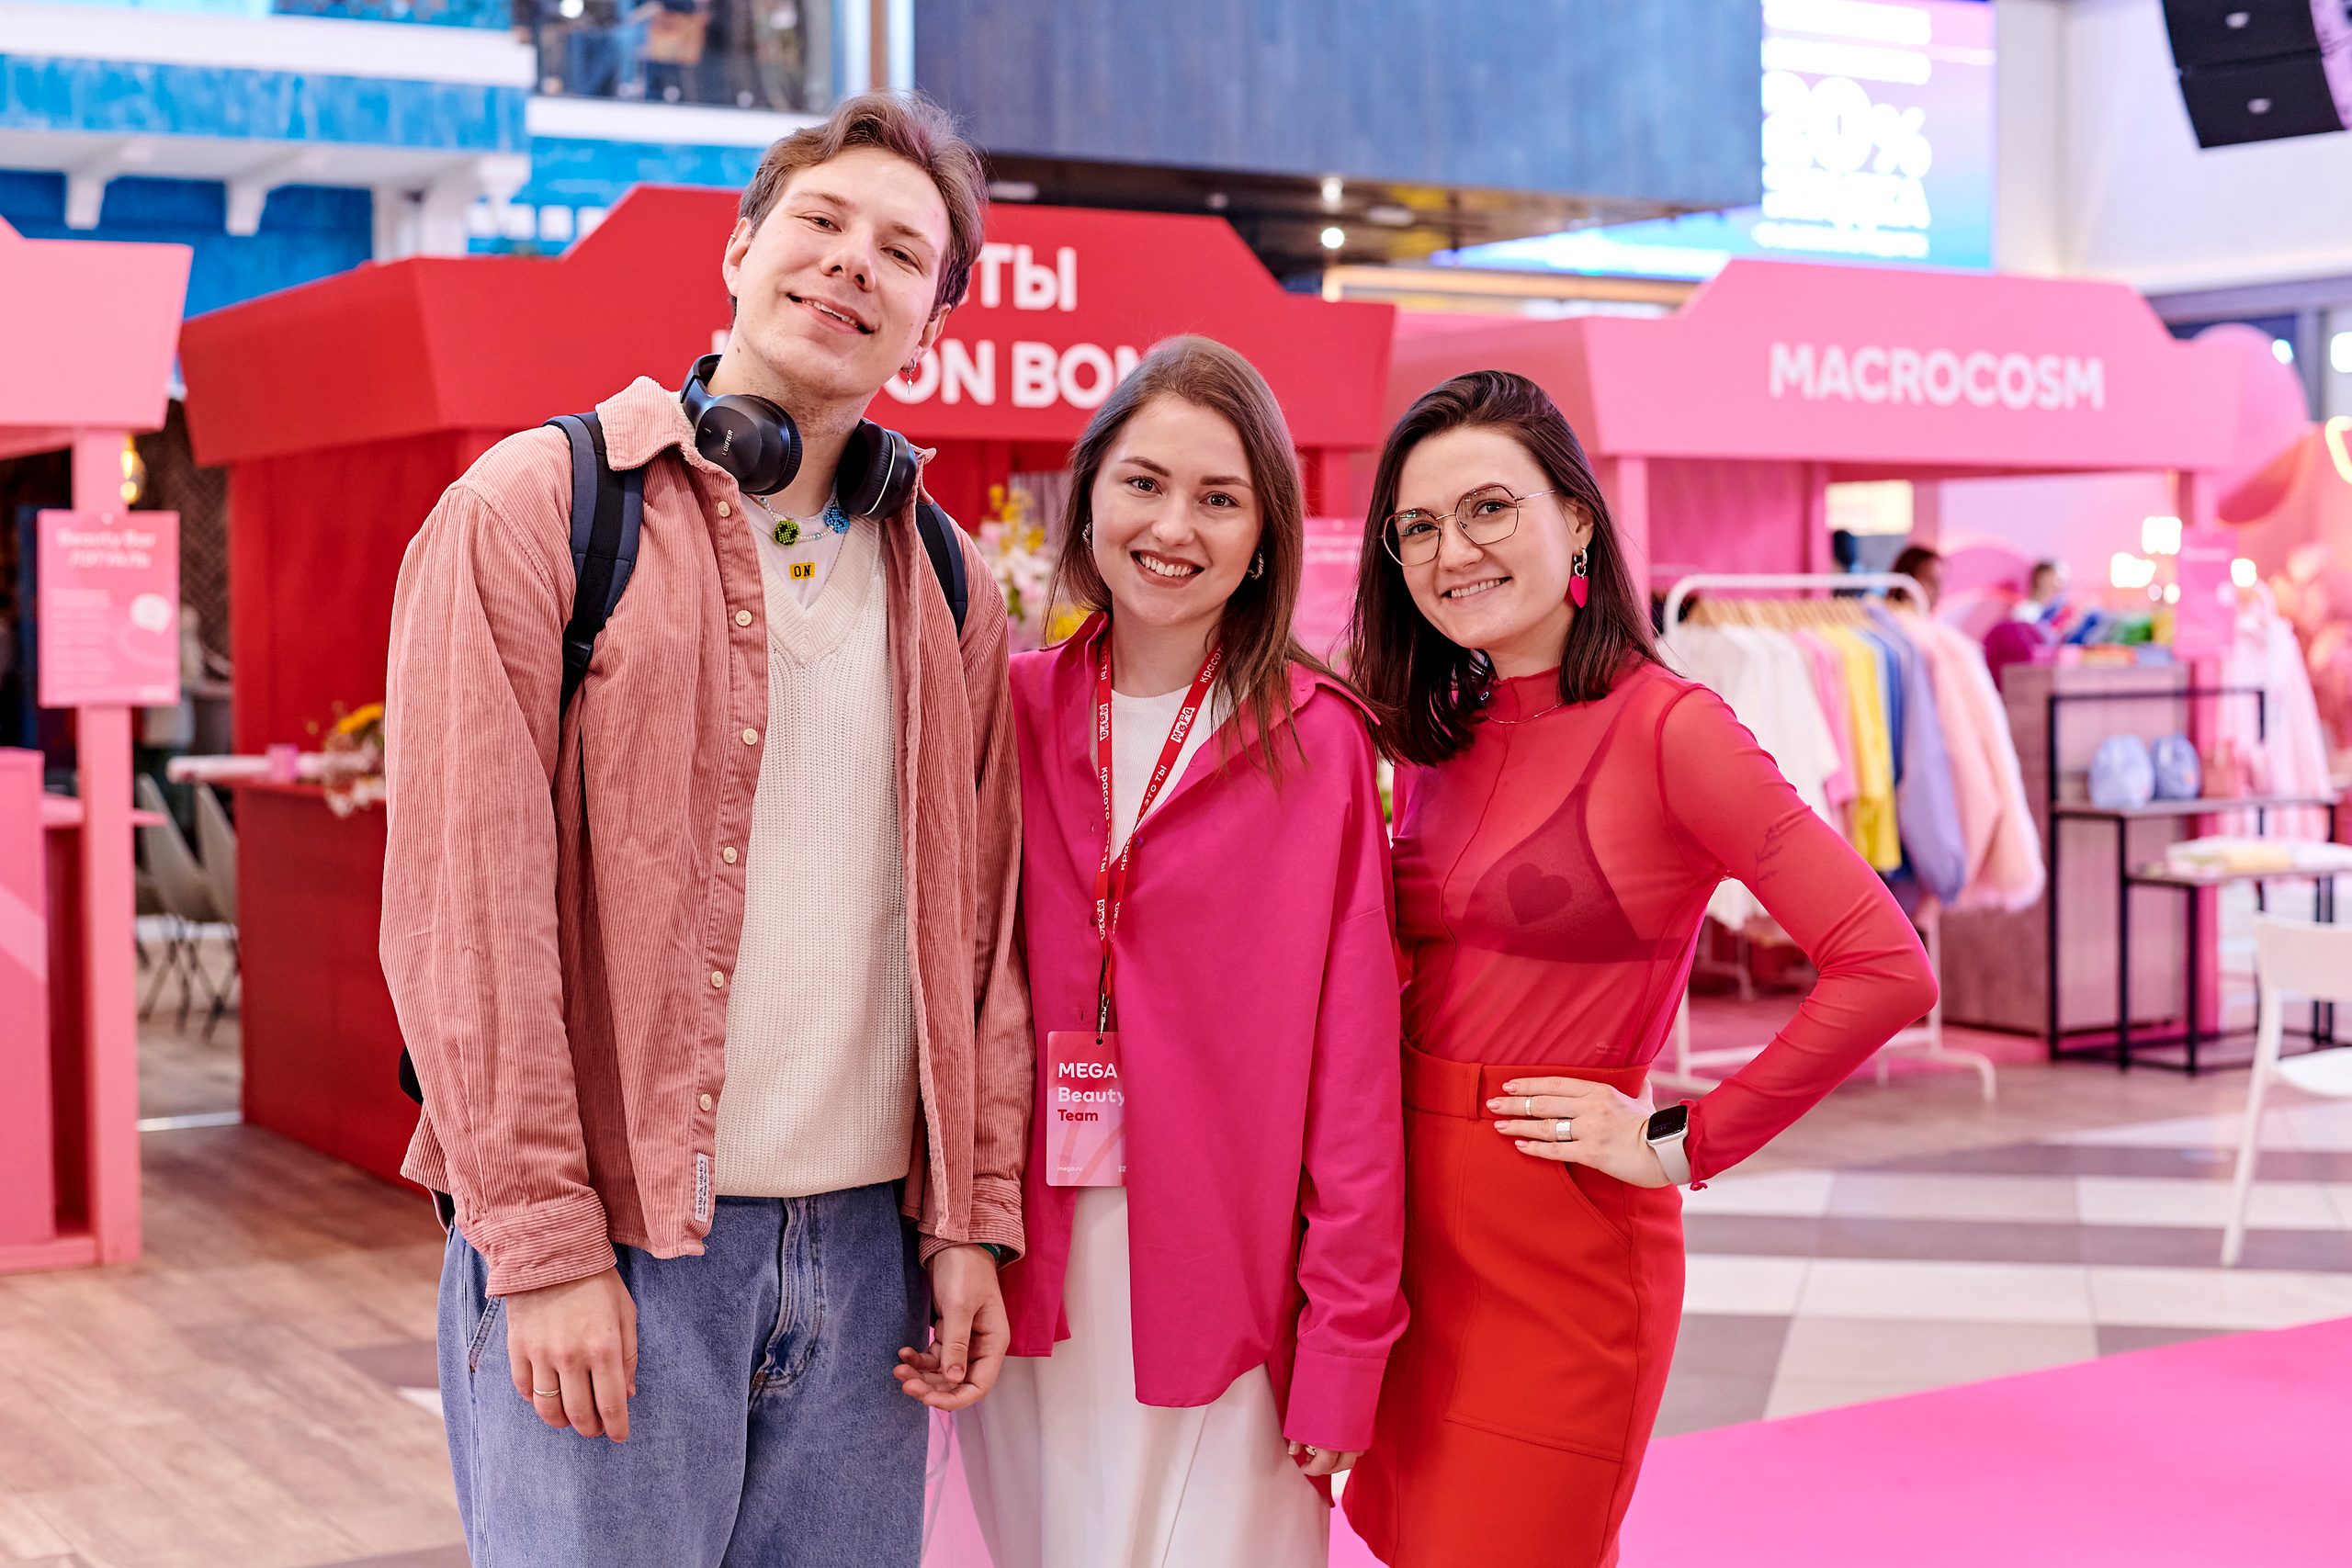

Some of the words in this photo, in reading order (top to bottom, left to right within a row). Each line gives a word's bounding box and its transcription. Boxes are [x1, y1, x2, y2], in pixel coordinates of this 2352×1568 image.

[960, 242, 1078, 312] ТЫ
[1769, 341, 2106, 412] MACROCOSM
[721, 429, 733, 456] EDIFIER
[793, 564, 812, 578] ON
[1199, 643, 1224, 683] красот
[1100, 766, 1110, 820] красота
[1144, 784, 1157, 807] это
[1154, 764, 1168, 782] ты
[1100, 854, 1108, 873] ты
[1057, 1063, 1118, 1078] MEGA
[1057, 1087, 1125, 1107] Beauty
[1057, 1109, 1099, 1122] Team
